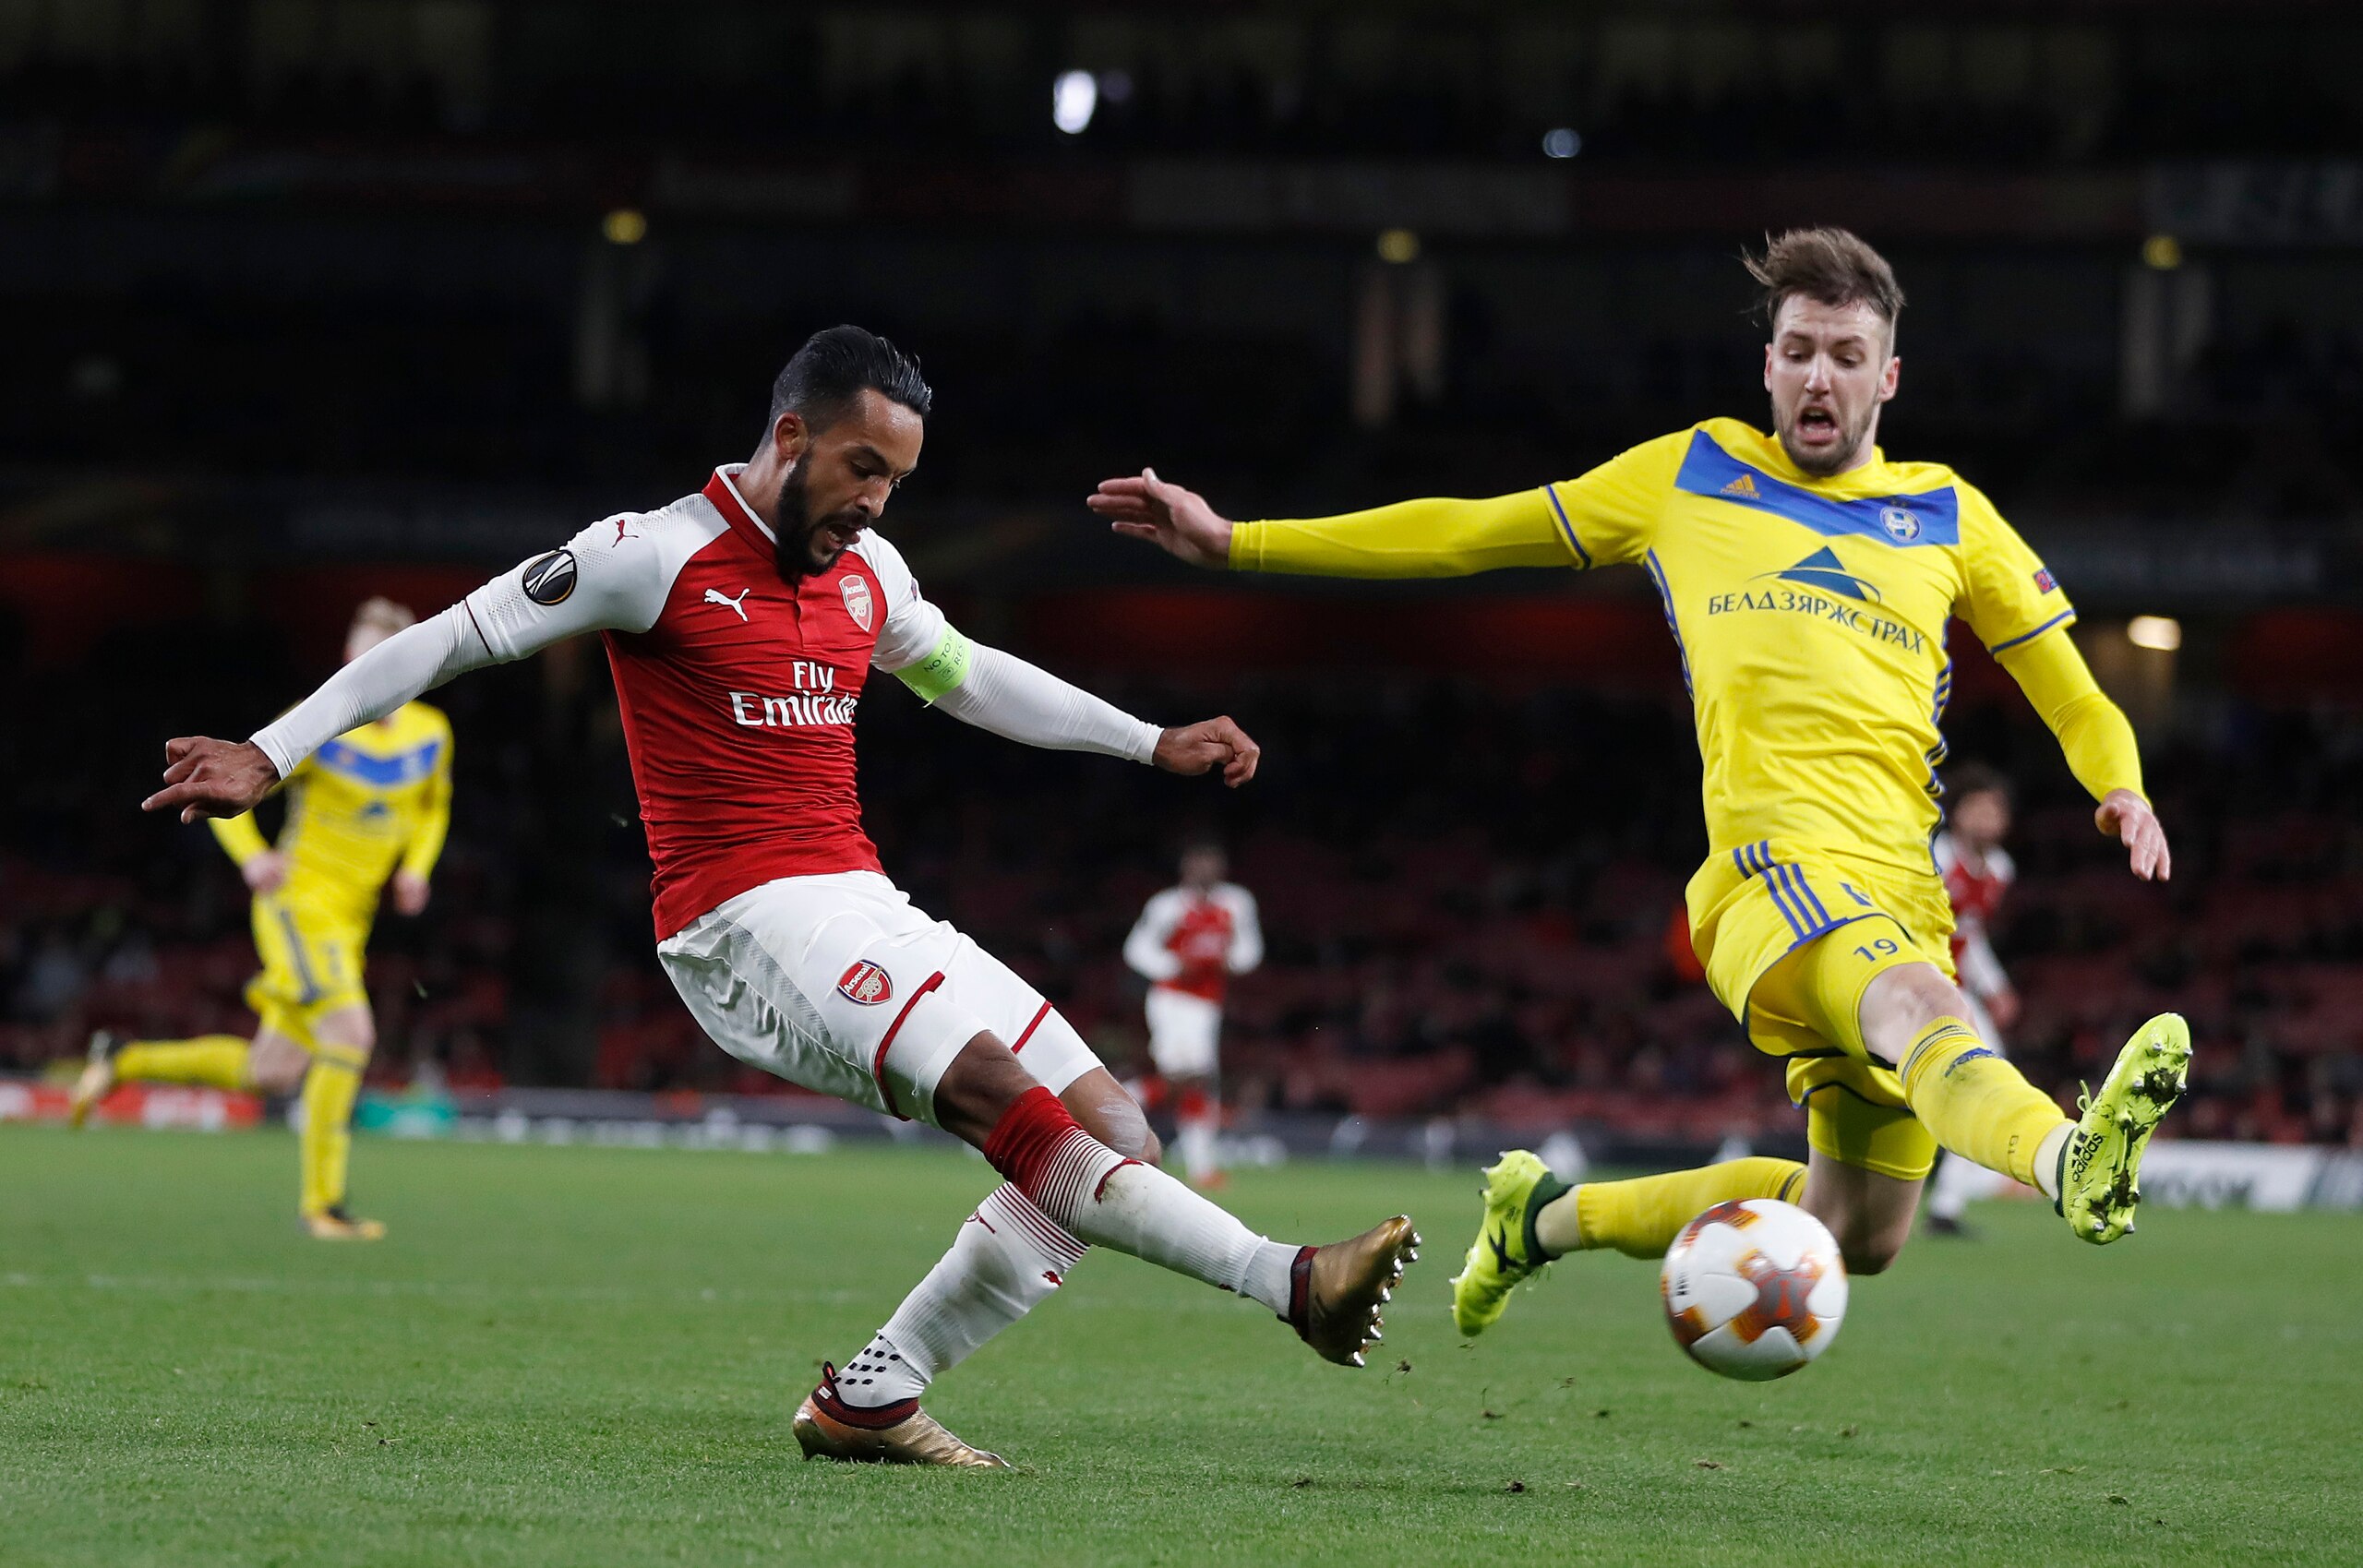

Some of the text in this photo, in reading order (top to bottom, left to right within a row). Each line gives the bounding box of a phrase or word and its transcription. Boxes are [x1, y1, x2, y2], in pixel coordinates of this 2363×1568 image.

[1708, 591, 1926, 655] БЕЛДЗЯРЖСТРАХ
[924, 659, 942, 673] NO
[941, 642, 952, 658] TO
[954, 643, 965, 665] RES
[792, 661, 834, 694] Fly
[728, 689, 858, 726] Emirate
[1853, 939, 1898, 963] 19
[843, 964, 871, 994] Arsenal
[2072, 1132, 2104, 1182] adidas
